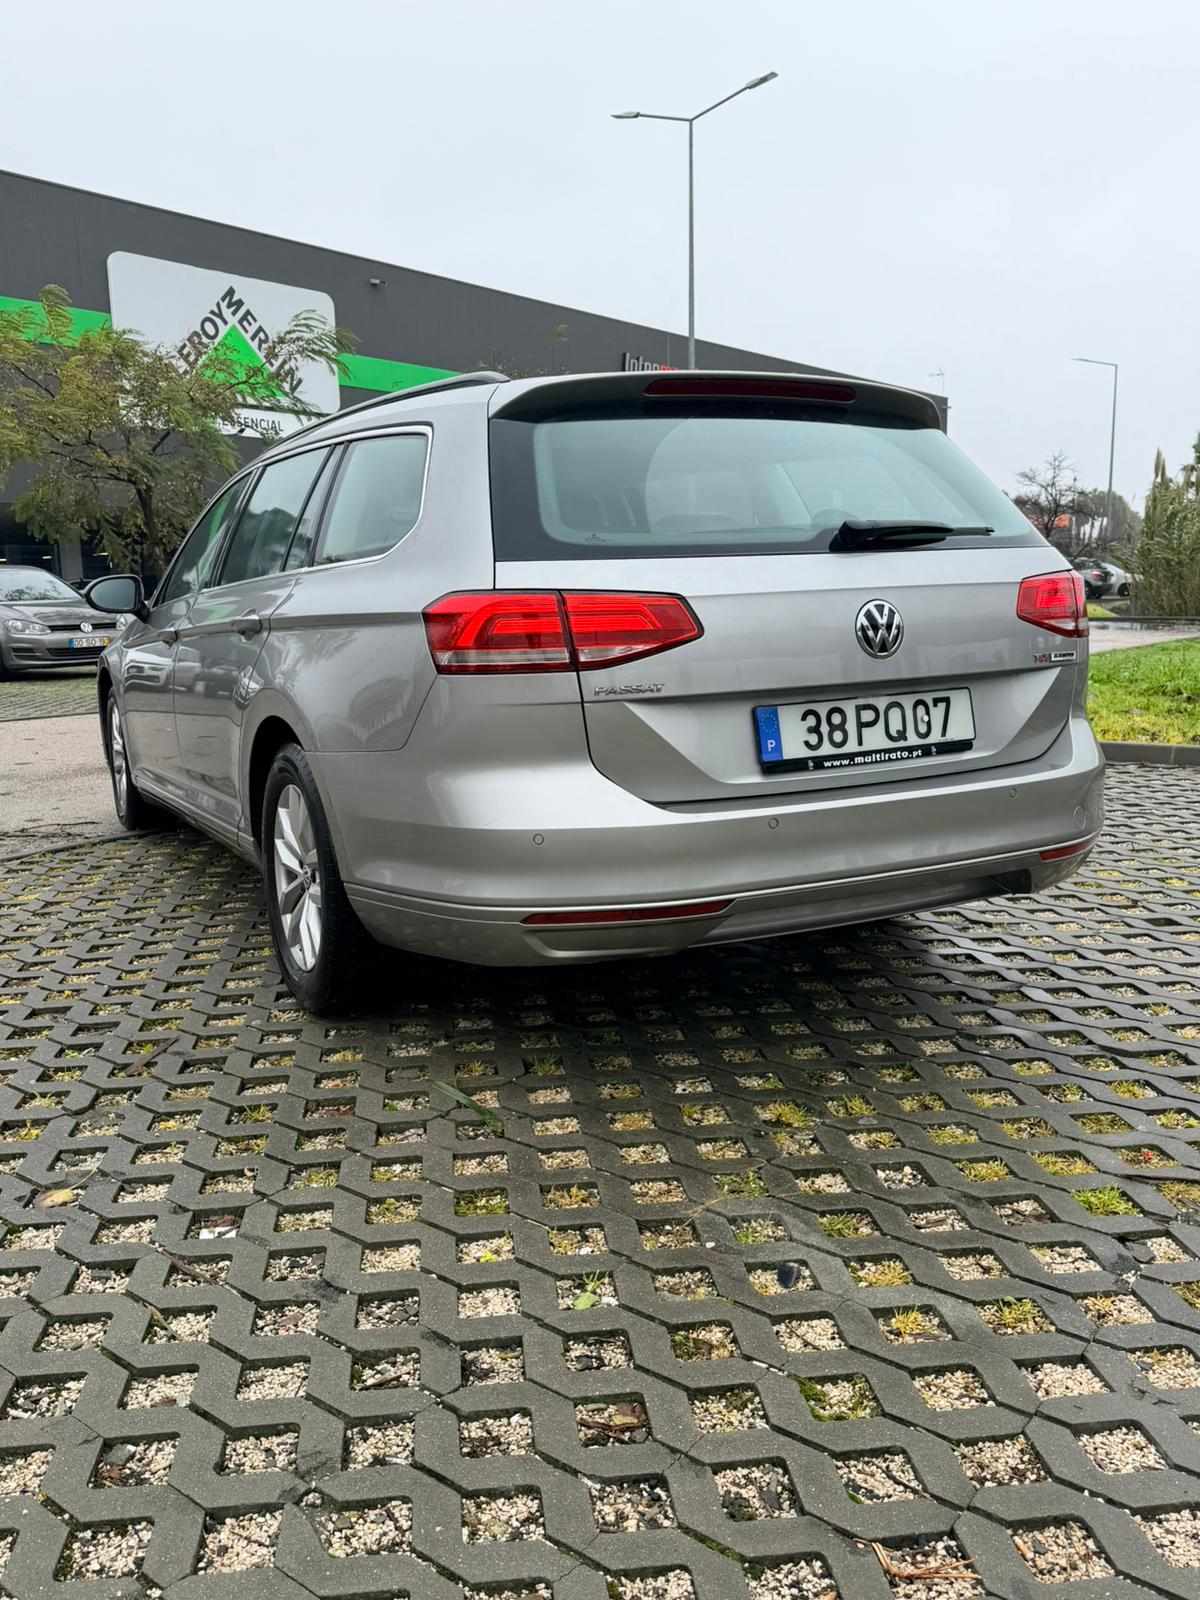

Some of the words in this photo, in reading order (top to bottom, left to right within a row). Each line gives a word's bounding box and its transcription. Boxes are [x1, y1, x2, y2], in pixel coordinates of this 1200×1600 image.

[594, 683, 664, 697] PASSAT
[767, 740, 776, 752] P
[823, 748, 923, 768] www.multirato.pt
